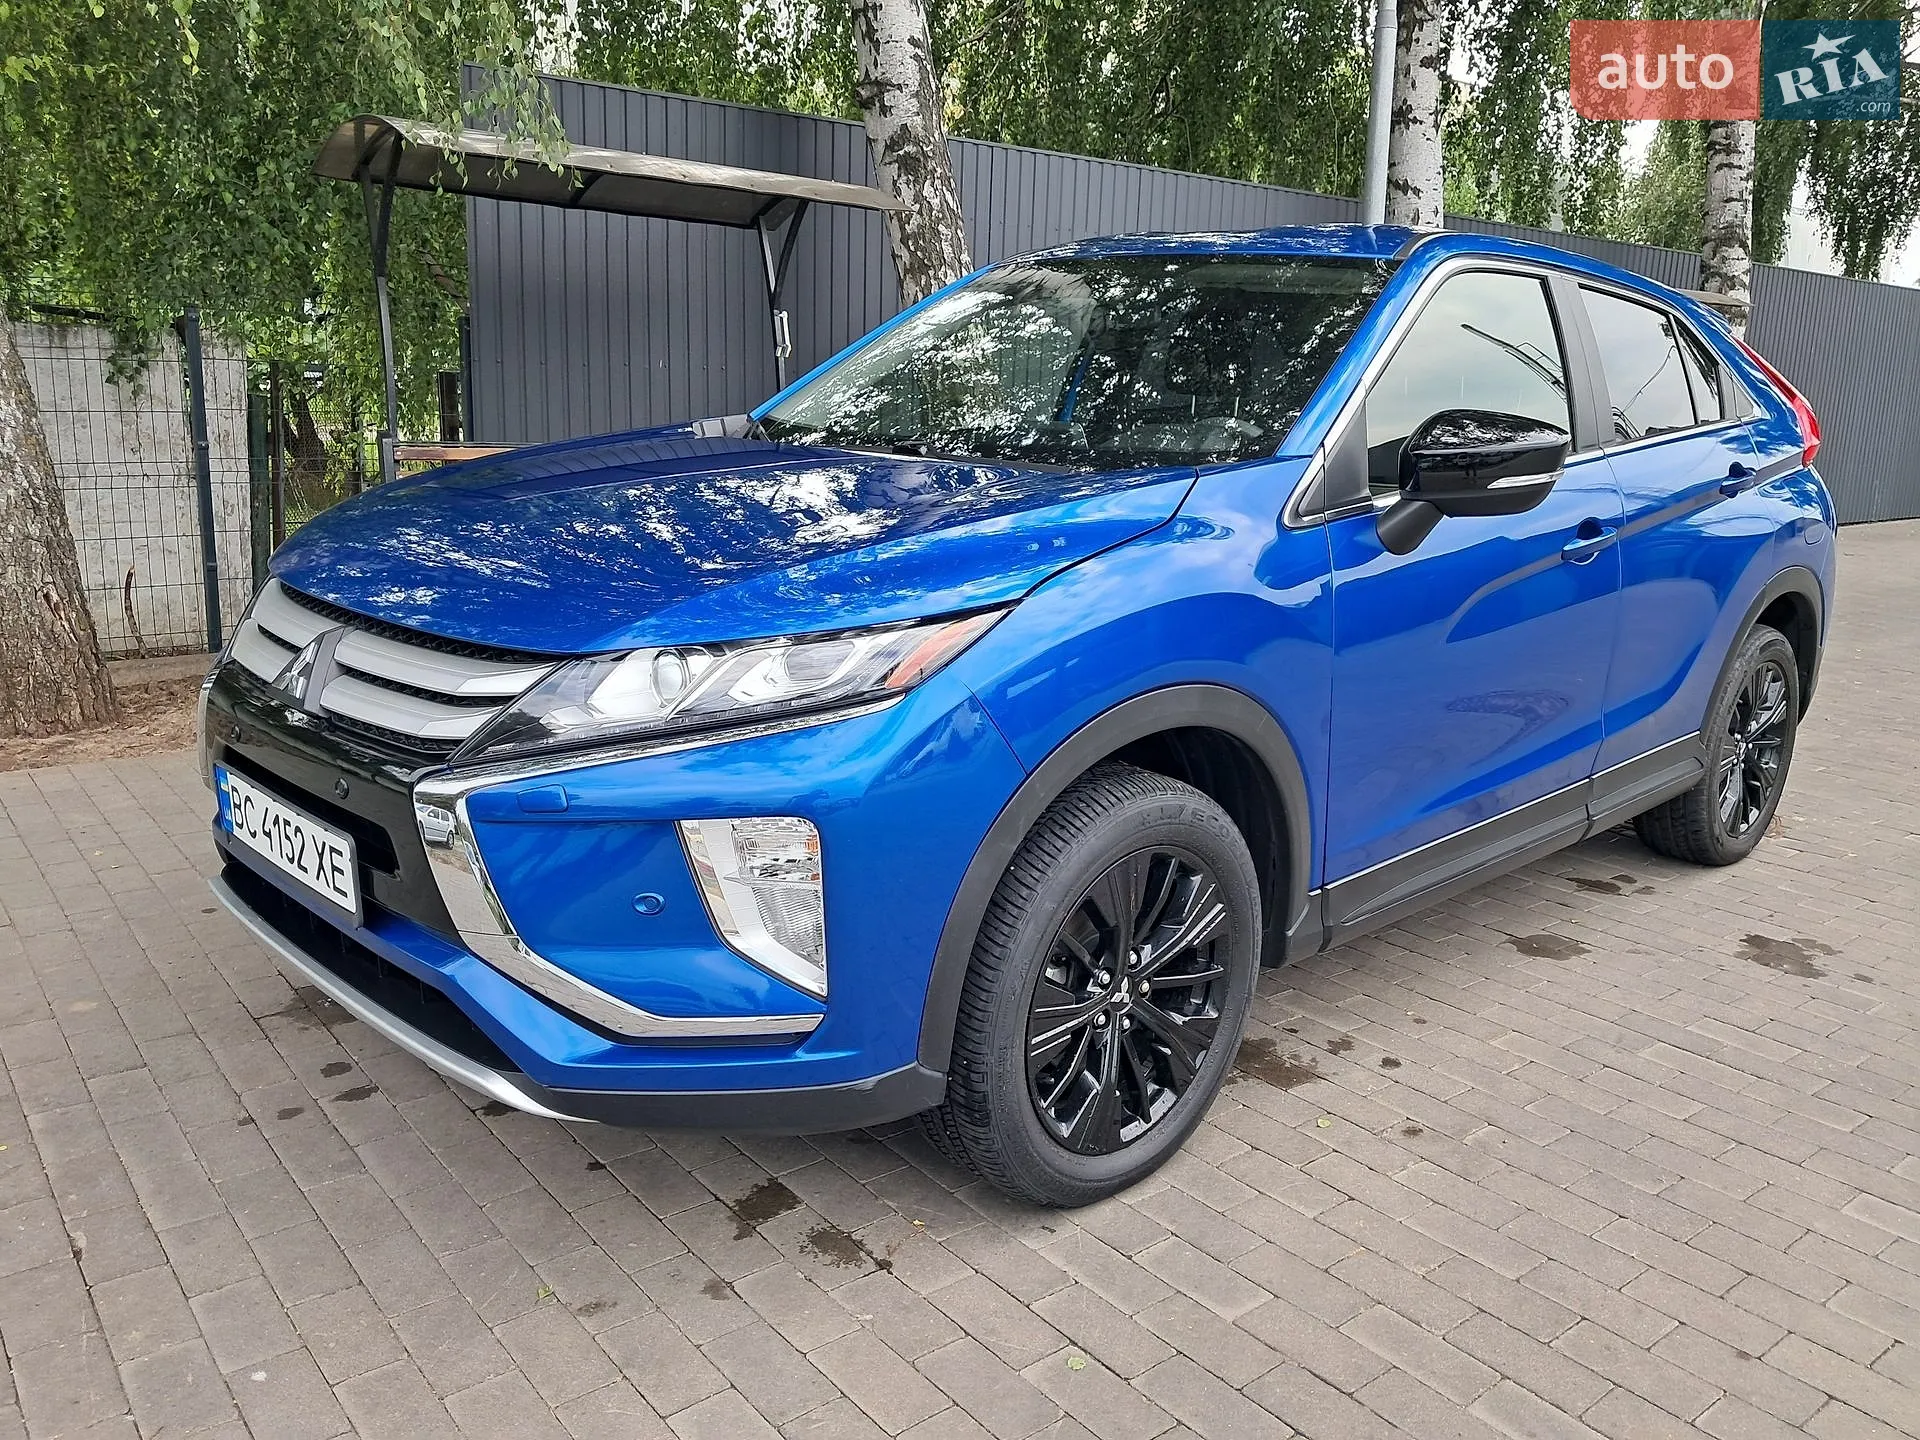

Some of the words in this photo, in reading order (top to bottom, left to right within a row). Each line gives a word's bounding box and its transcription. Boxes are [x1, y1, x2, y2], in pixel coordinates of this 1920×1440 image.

[231, 785, 257, 839] BC
[262, 807, 309, 875] 4152
[312, 834, 348, 898] XE
